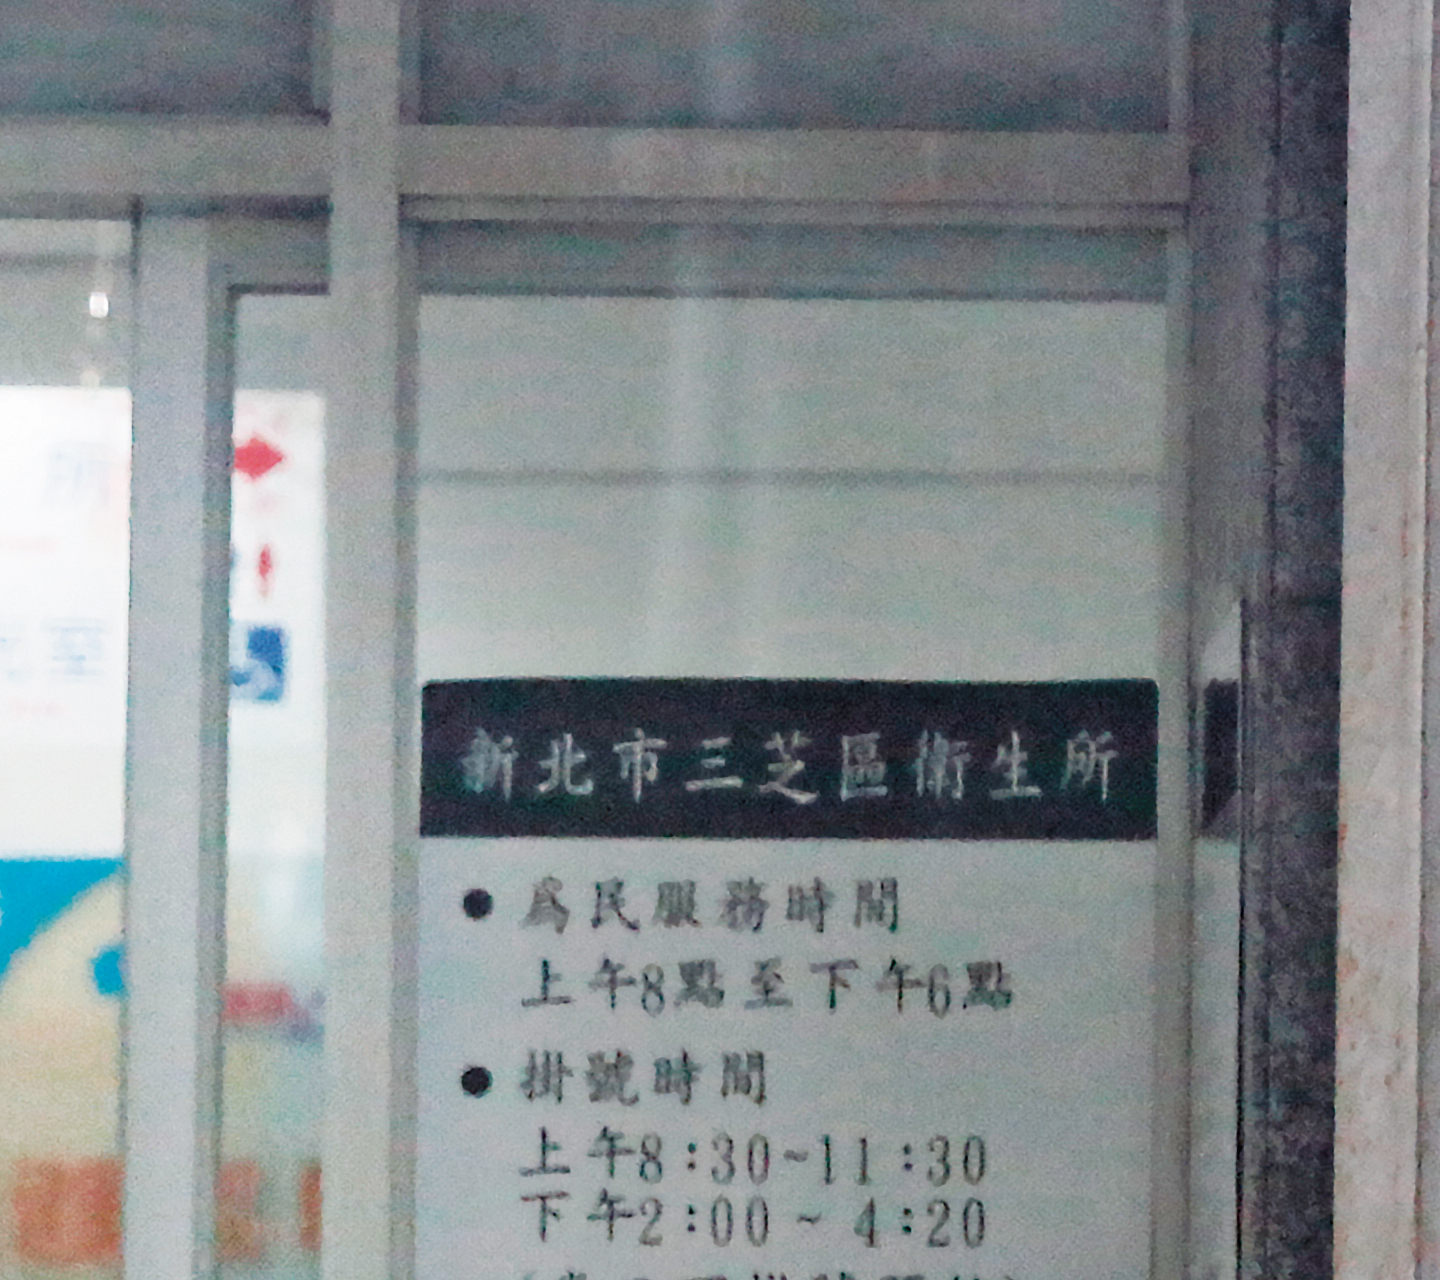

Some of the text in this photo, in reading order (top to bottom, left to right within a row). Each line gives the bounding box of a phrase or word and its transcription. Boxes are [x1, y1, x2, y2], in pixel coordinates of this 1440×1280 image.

[461, 727, 1119, 804] 新北市三芝區衛生所
[522, 957, 1013, 1016] 上午8點至下午6點
[522, 1048, 767, 1105] 掛號時間
